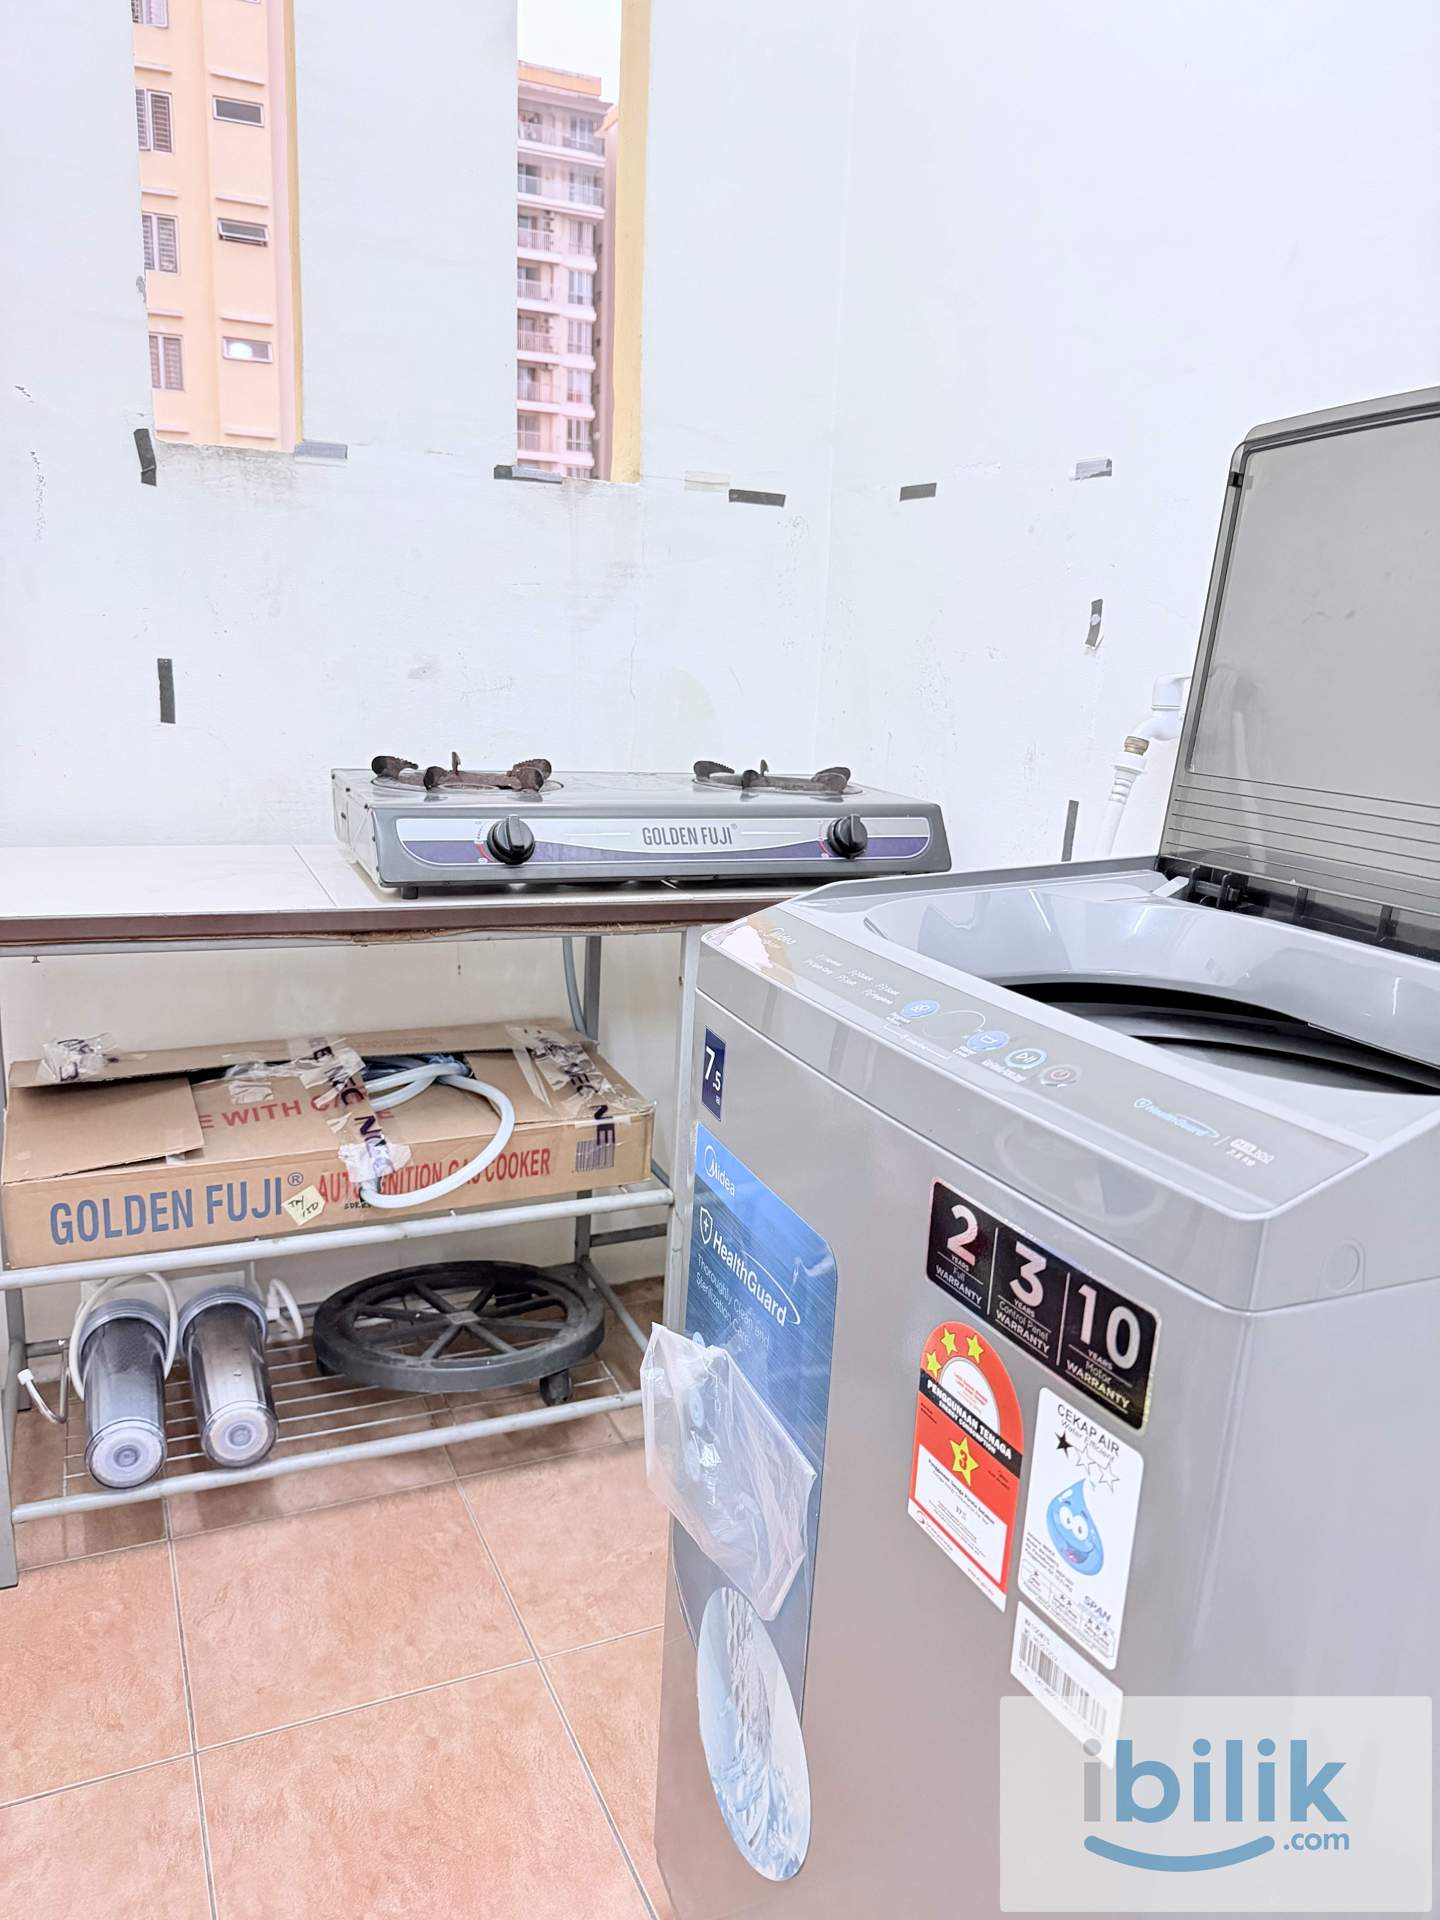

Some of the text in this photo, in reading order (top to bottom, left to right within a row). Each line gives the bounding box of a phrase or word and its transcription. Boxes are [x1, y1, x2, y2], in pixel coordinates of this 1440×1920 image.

[641, 826, 698, 846] GOLDEN
[221, 1100, 303, 1127] WITH
[704, 1145, 736, 1197] Midea
[50, 1187, 194, 1246] GOLDEN
[946, 1203, 979, 1267] 2
[698, 1253, 733, 1307] Thoroughly
[712, 1230, 788, 1328] HealthGuard
[935, 1264, 983, 1305] WARRANTY
[950, 1254, 970, 1272] YEARS
[952, 1266, 966, 1281] Full
[1008, 1240, 1047, 1307] 3
[695, 1271, 733, 1324] Sterilization
[999, 1300, 1049, 1342] Control Panel
[1013, 1298, 1036, 1319] YEARS
[995, 1308, 1051, 1354] WARRANTY
[1078, 1283, 1141, 1370] 10
[1066, 1359, 1131, 1409] WARRANTY
[1084, 1360, 1112, 1385] Motor
[1087, 1349, 1113, 1371] YEARS
[926, 1379, 979, 1430] PENGGUNAAN
[979, 1423, 1012, 1461] TENAGA
[1057, 1403, 1120, 1457] CEKAP AIR
[959, 1449, 968, 1471] 3
